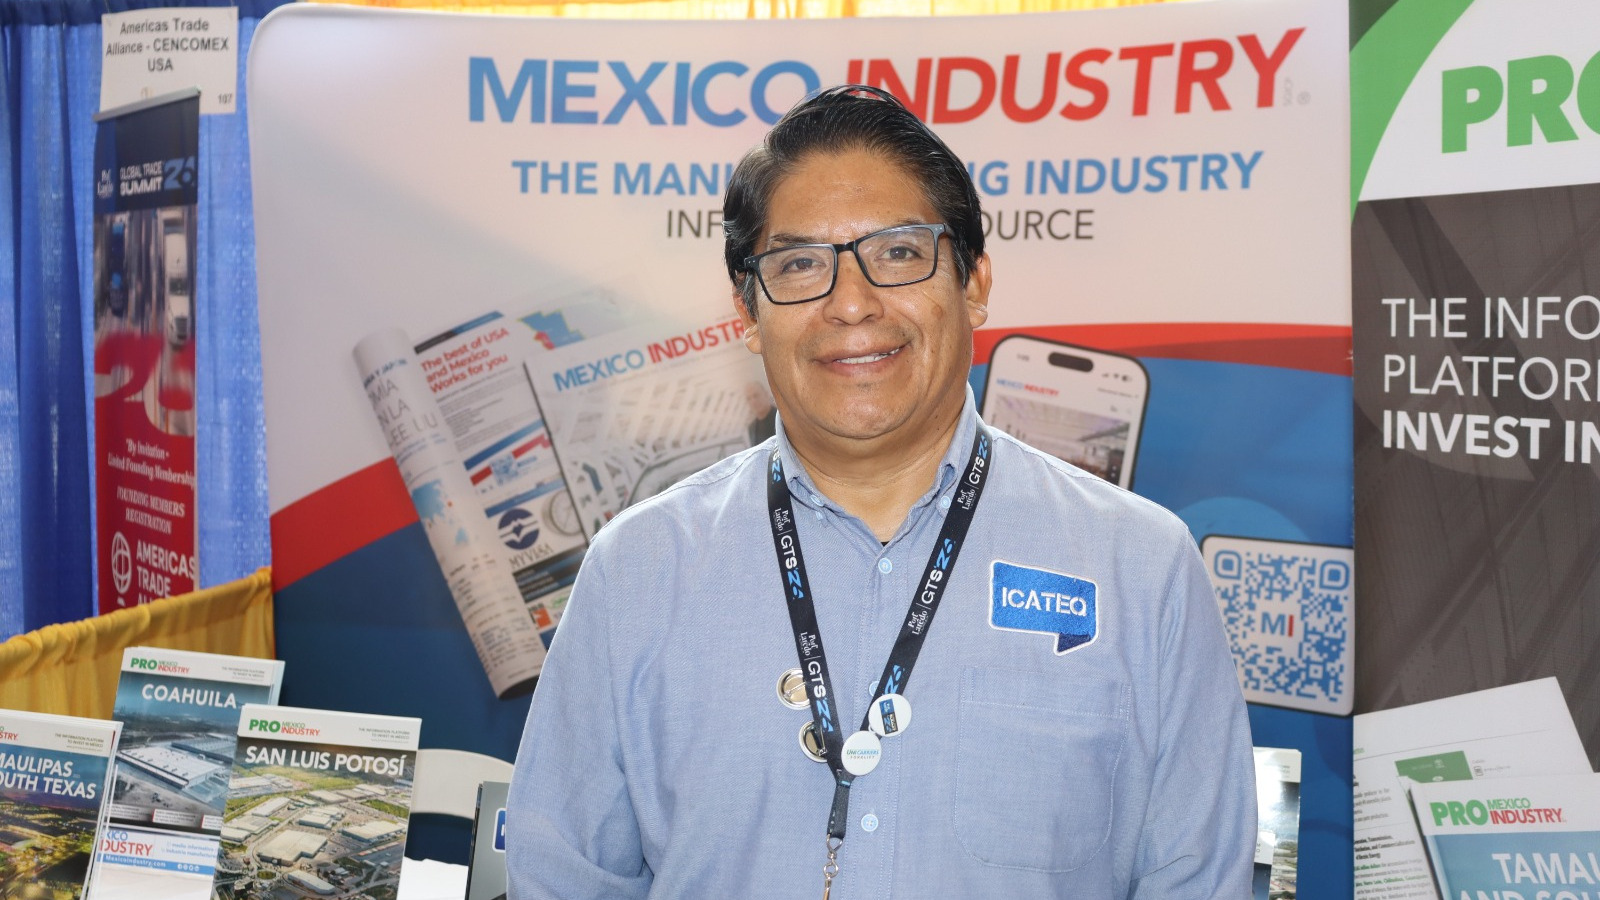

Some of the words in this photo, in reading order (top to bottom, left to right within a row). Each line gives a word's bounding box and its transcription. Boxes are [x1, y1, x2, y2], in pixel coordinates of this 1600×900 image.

[120, 20, 168, 35] Americas
[173, 18, 209, 32] Trade
[106, 42, 142, 56] Alliance
[153, 37, 229, 52] CENCOMEX
[147, 58, 174, 72] USA
[218, 93, 233, 104] 107
[469, 56, 822, 127] MEXICO
[120, 165, 142, 180] GLOBAL
[143, 160, 162, 176] TRADE
[512, 160, 597, 195] THE
[1025, 151, 1264, 195] INDUSTRY
[120, 176, 163, 196] SUMMIT
[1382, 297, 1467, 338] THE
[1485, 295, 1600, 340] INFO
[421, 357, 442, 371] The
[443, 344, 469, 360] best
[471, 336, 482, 349] of
[484, 328, 509, 343] USA
[553, 349, 645, 392] MEXICO
[647, 318, 745, 364] INDUSTR
[426, 366, 448, 383] and
[449, 349, 489, 371] Mexico
[430, 372, 467, 393] Works
[468, 364, 483, 375] for
[487, 354, 508, 371] you
[1384, 354, 1600, 402] PLATFOR
[1383, 409, 1550, 460] INVEST
[126, 457, 154, 482] Founding
[117, 485, 149, 508] FOUNDING
[150, 494, 185, 518] MEMBERS
[125, 507, 172, 535] REGISTRATION
[136, 539, 196, 581] AMERICAS
[136, 565, 171, 599] TRADE
[1001, 586, 1087, 617] ICATEQ
[1260, 611, 1294, 638] MI
[130, 657, 157, 670] PRO
[157, 665, 190, 675] INDUSTRY
[141, 683, 237, 709] COAHUILA
[249, 718, 281, 733] PRO
[281, 727, 320, 737] INDUSTRY
[245, 746, 286, 766] SAN
[291, 750, 331, 770] LUIS
[334, 754, 407, 776] POTOSÍ
[43, 776, 97, 799] TEXAS
[1429, 799, 1488, 827] PRO
[1487, 797, 1531, 809] MEXICO
[1490, 808, 1562, 824] INDUSTRY
